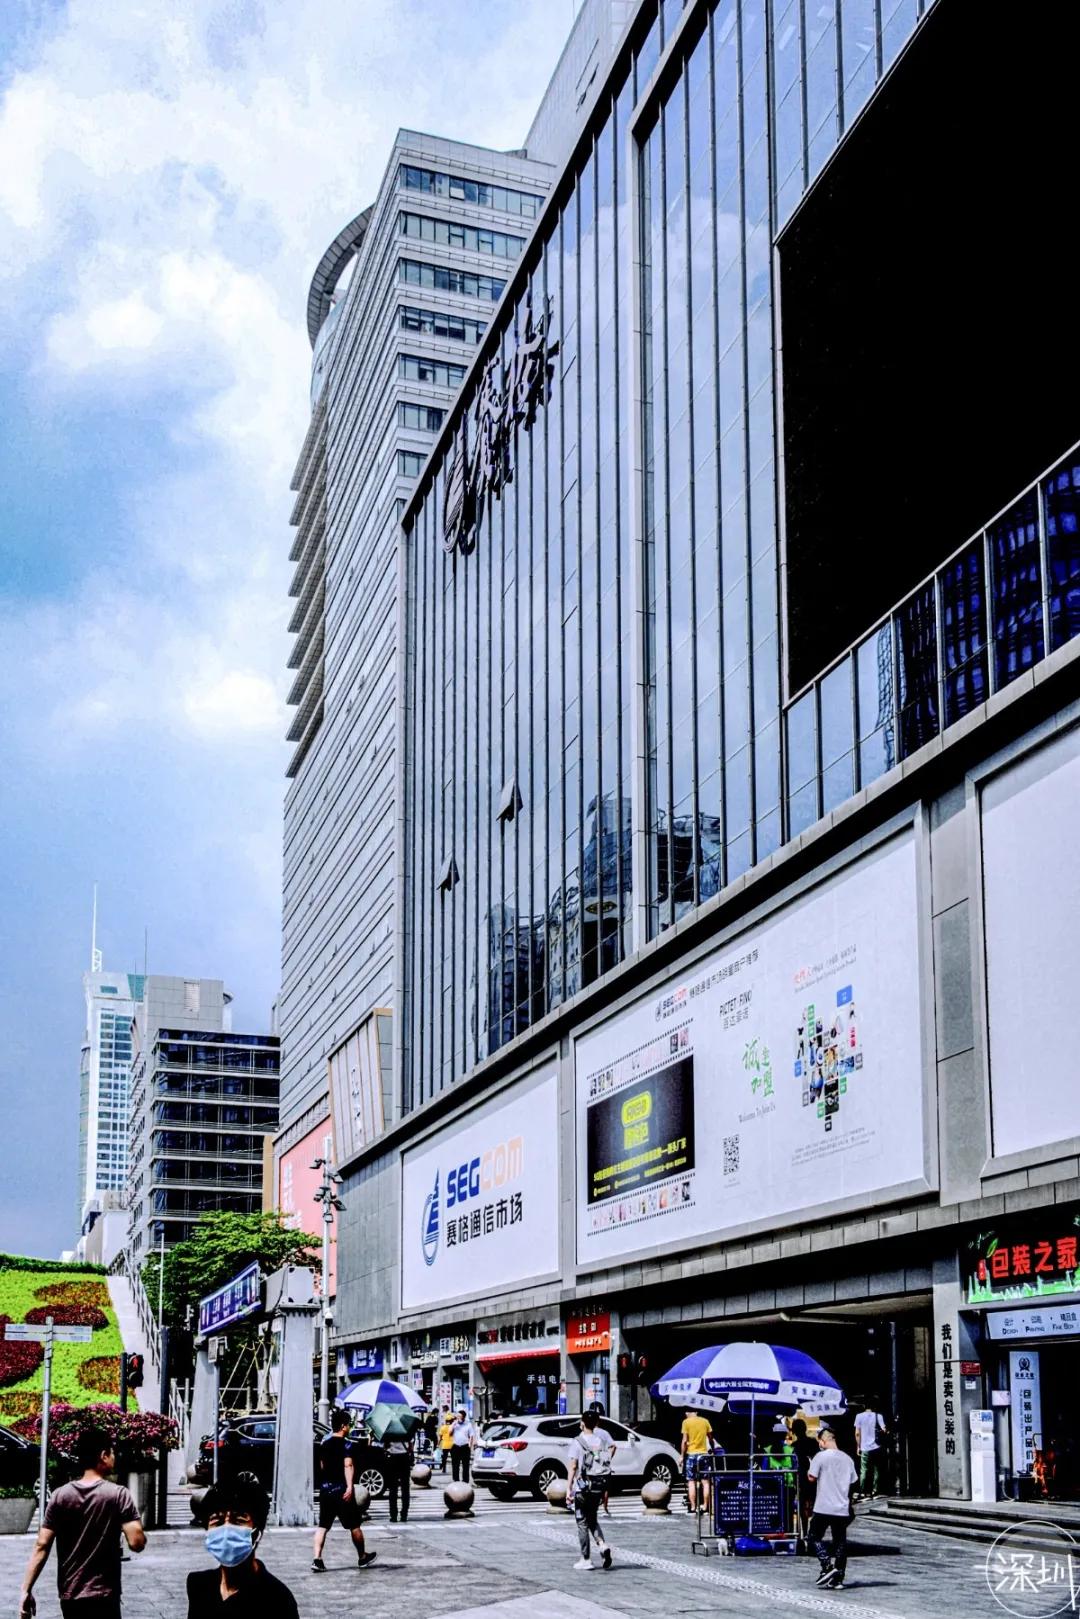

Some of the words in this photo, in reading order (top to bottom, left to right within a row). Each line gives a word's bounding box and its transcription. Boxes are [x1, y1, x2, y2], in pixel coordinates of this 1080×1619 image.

[446, 1136, 523, 1208] SEGCOM
[446, 1191, 523, 1247] 赛格通信市场
[992, 1237, 1077, 1279] 包装之家
[527, 1374, 561, 1384] 手机电
[941, 1324, 956, 1456] 我们是卖包装的
